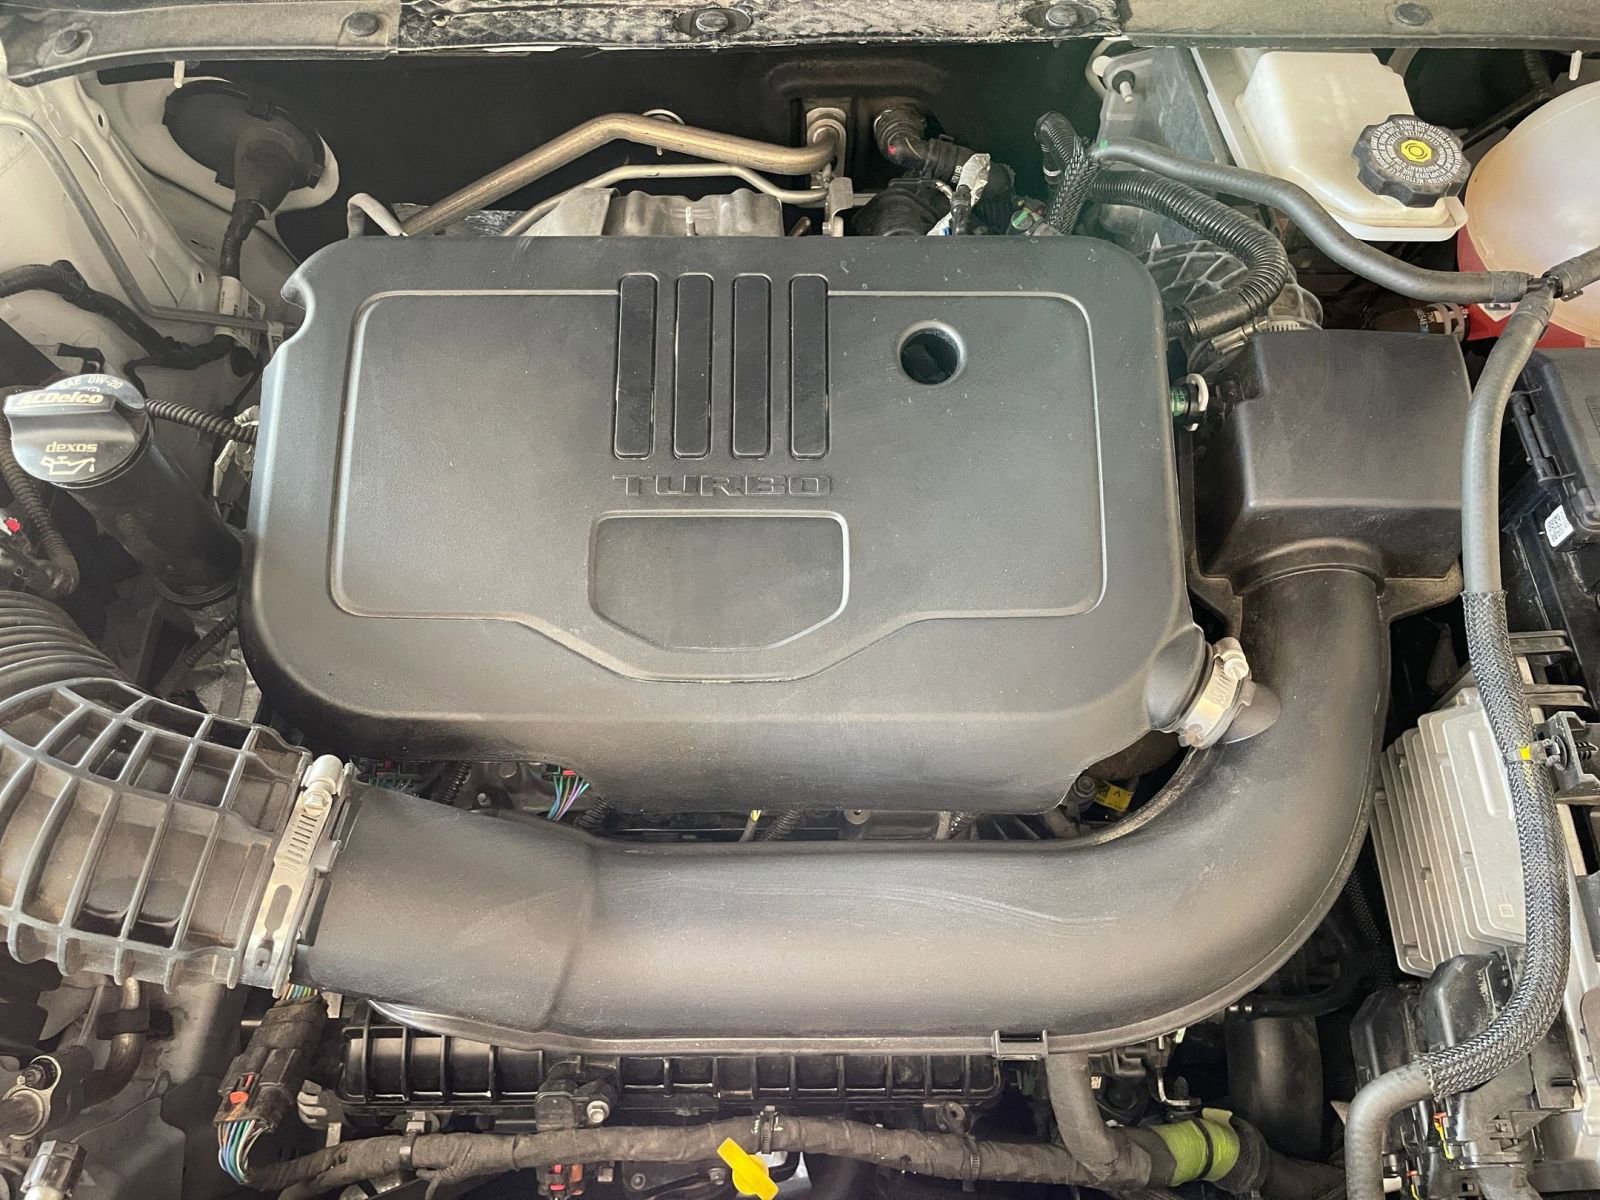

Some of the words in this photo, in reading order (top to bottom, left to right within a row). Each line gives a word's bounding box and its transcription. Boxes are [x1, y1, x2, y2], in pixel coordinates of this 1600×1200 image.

[17, 391, 104, 405] ACDelco
[45, 441, 98, 453] dexos
[612, 474, 832, 497] TURBO
